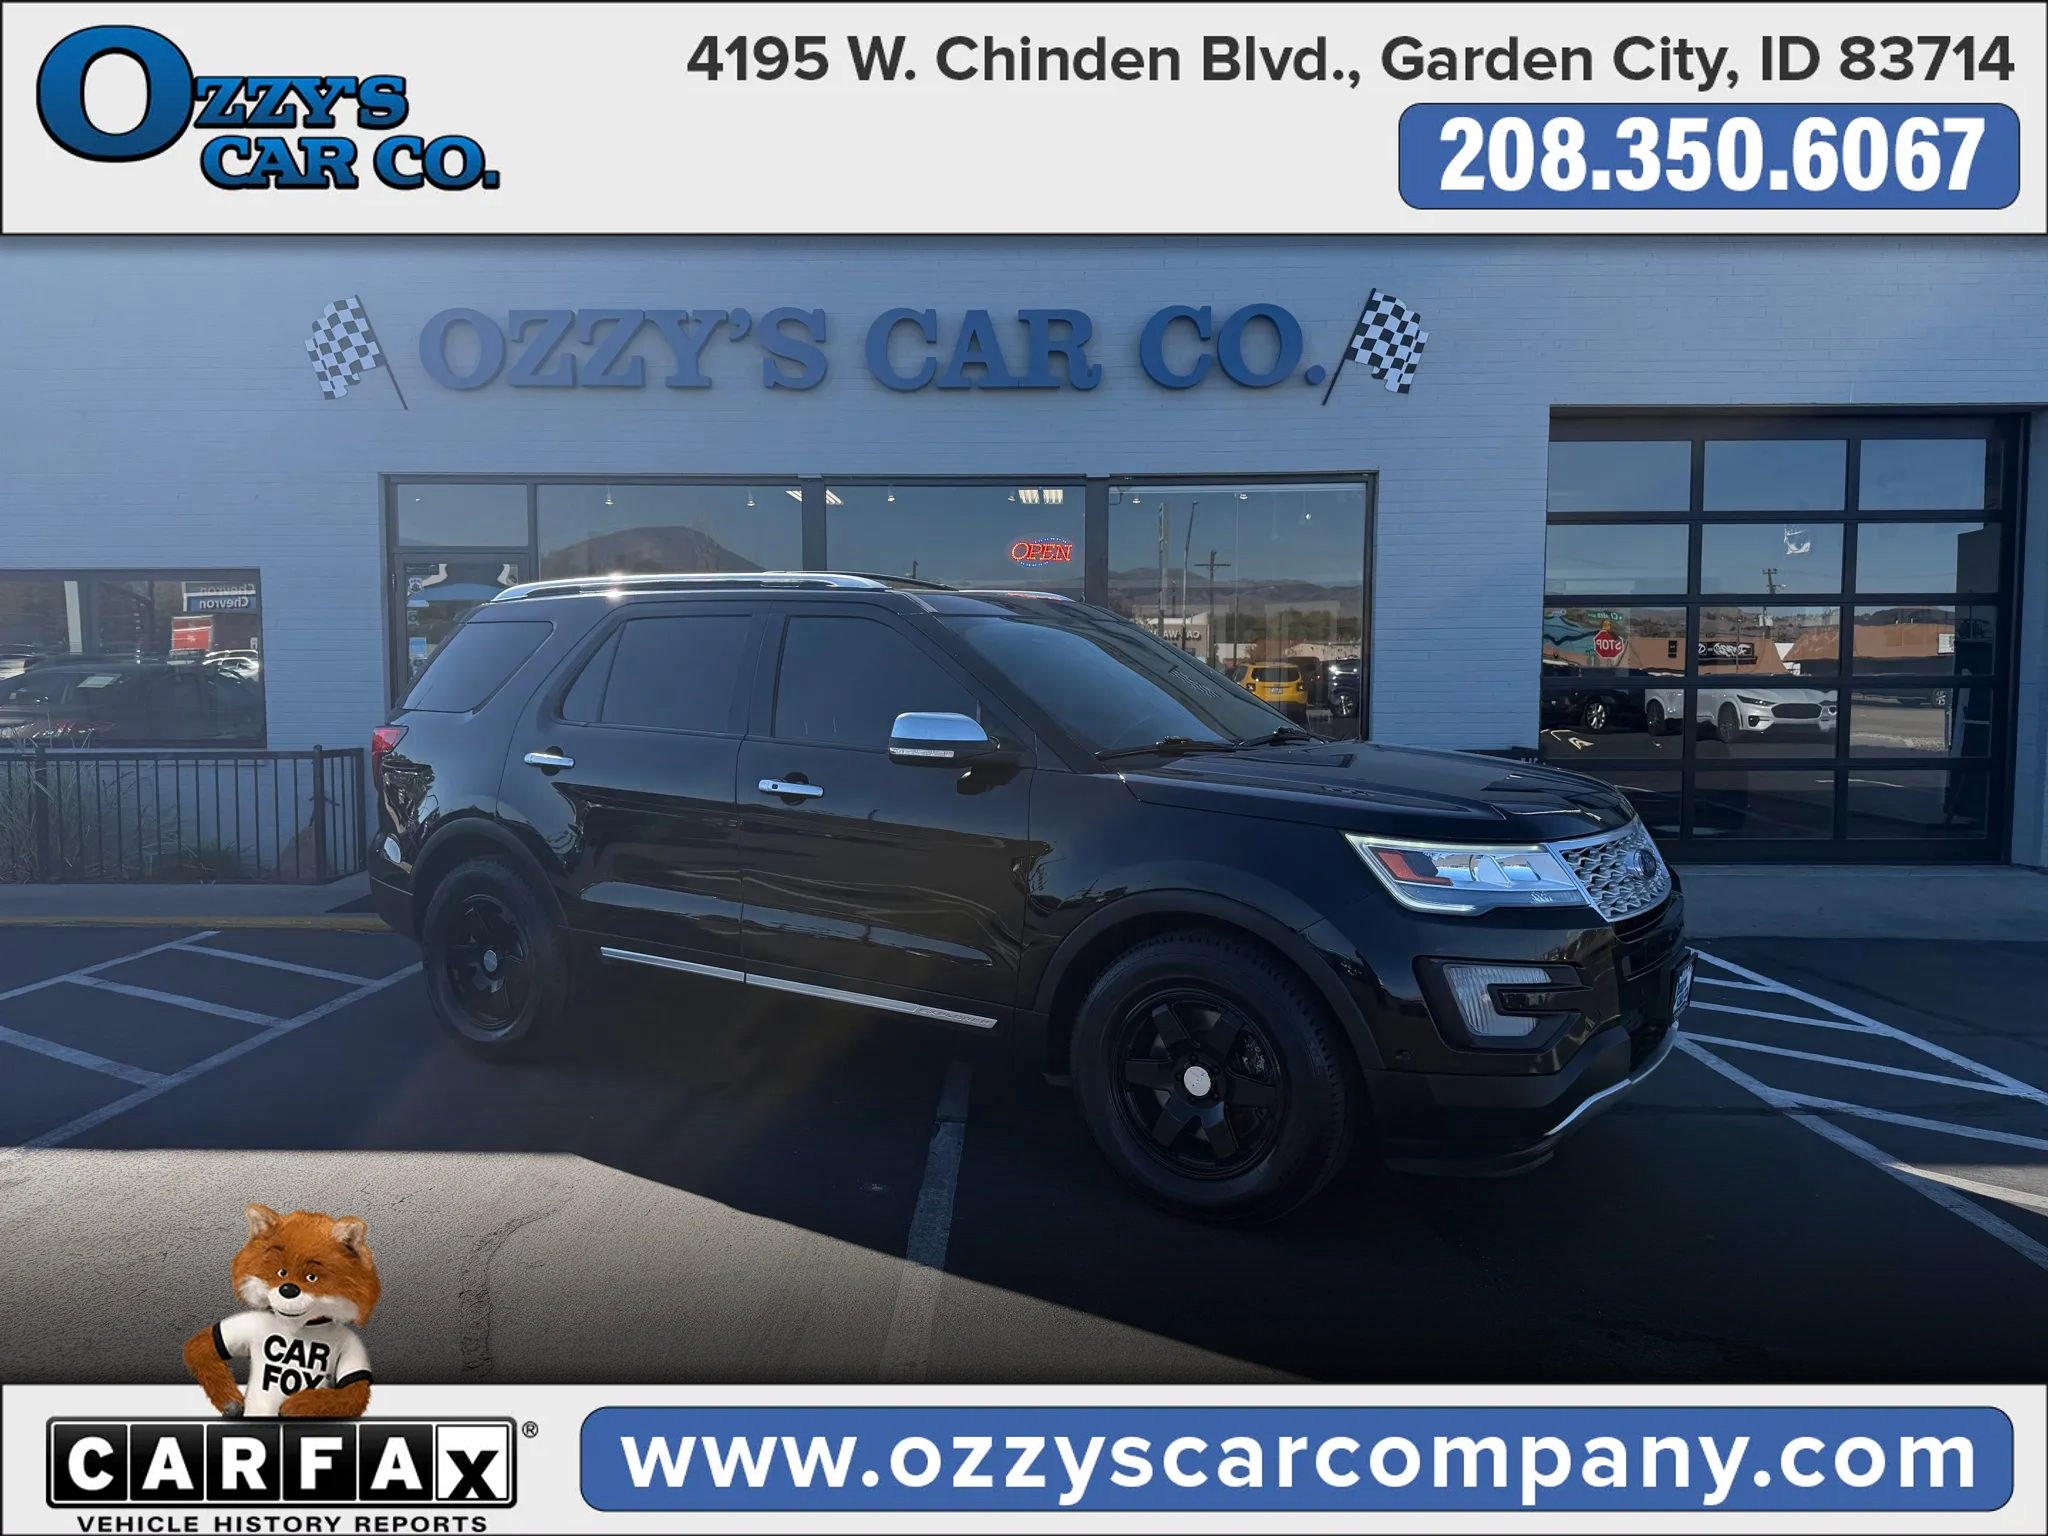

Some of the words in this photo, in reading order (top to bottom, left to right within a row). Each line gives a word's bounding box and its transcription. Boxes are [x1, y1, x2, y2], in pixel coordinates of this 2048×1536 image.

[419, 306, 827, 391] OZZY'S
[865, 307, 1102, 392] CAR
[1140, 303, 1326, 389] CO.
[1011, 542, 1073, 561] OPEN
